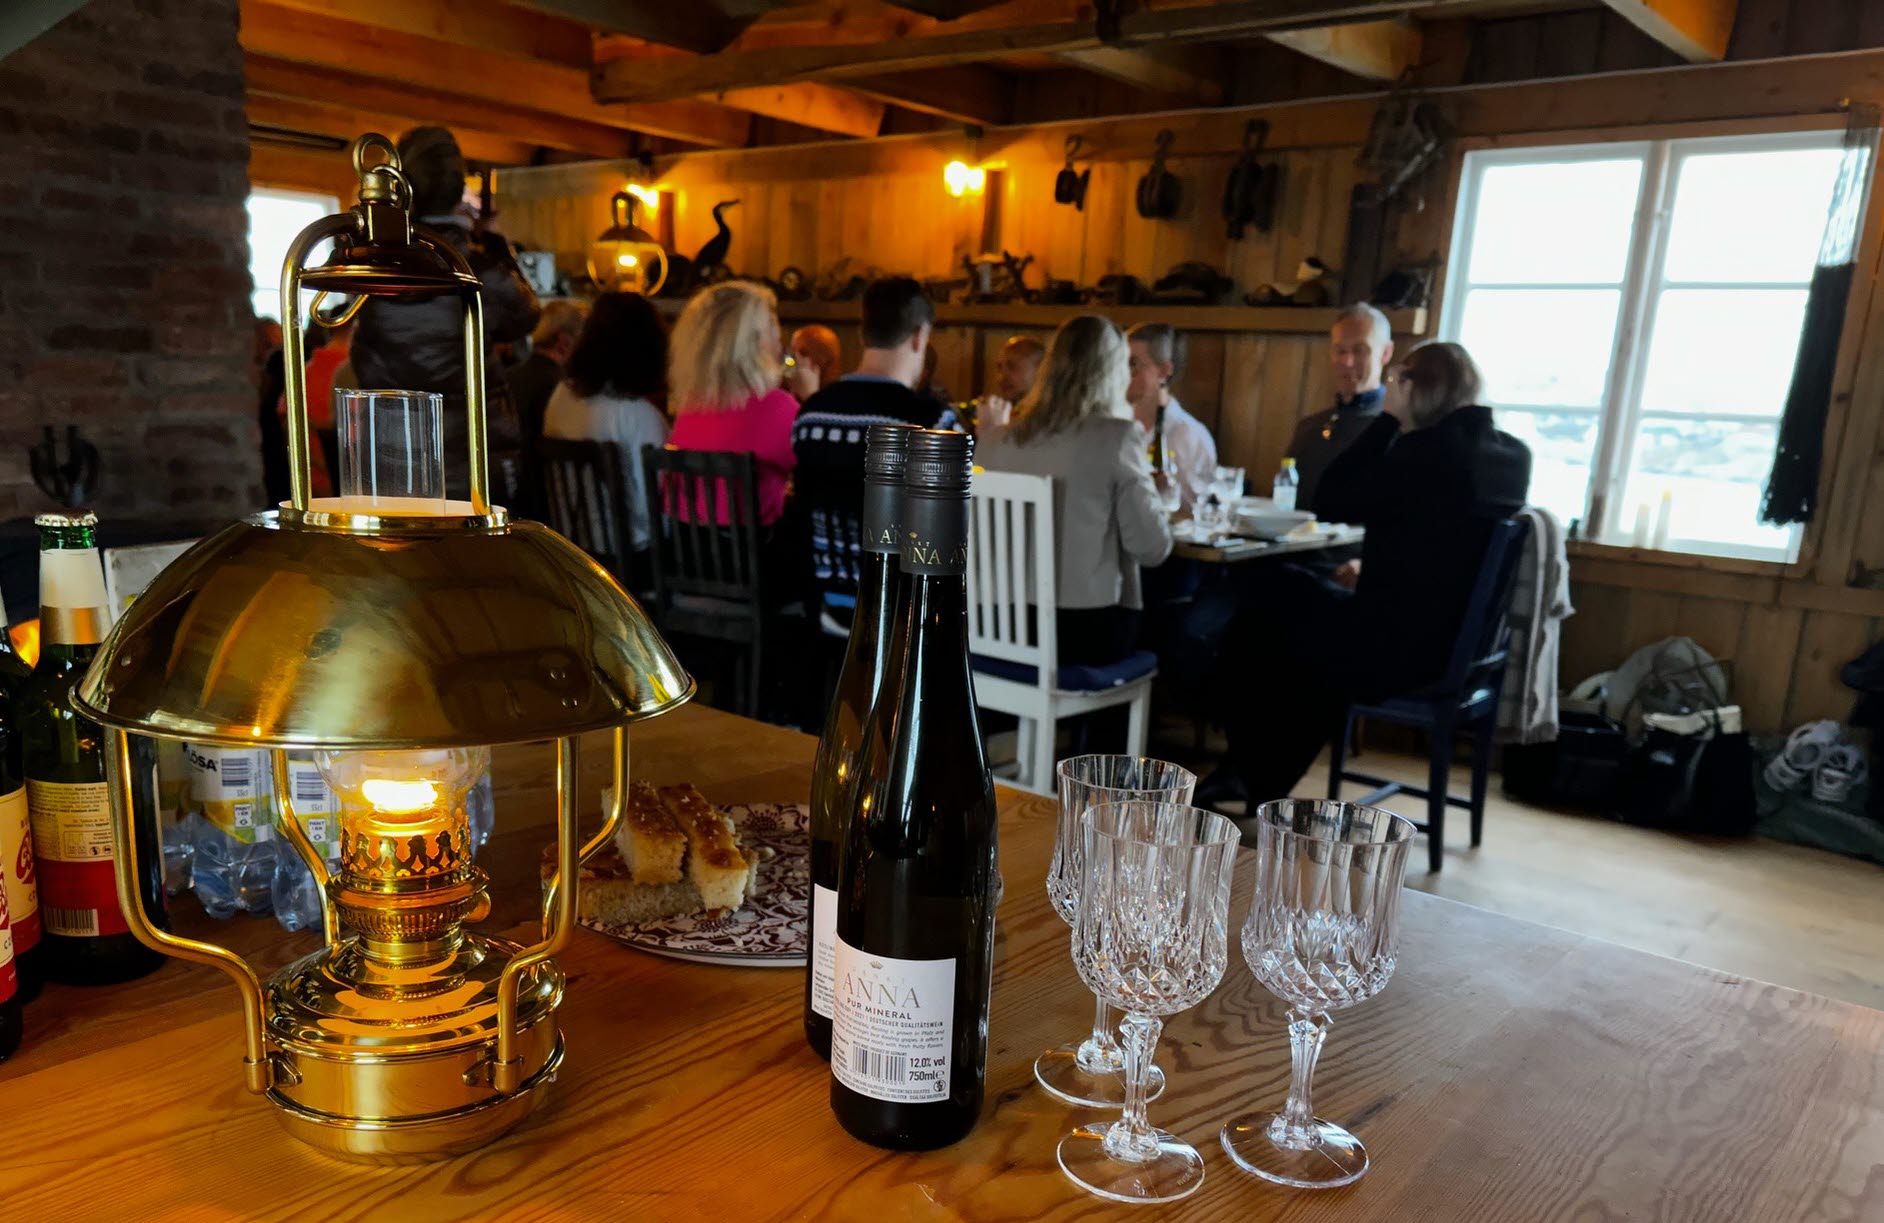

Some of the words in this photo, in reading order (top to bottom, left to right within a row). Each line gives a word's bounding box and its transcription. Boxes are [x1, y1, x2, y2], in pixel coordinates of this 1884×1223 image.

[842, 972, 921, 1009] ANNA
[847, 997, 862, 1010] PUR
[864, 1005, 912, 1020] MINERAL
[869, 1016, 899, 1028] DEUTSCHER
[900, 1021, 944, 1029] QUALITÄTSWEIN
[933, 1056, 945, 1067] vol
